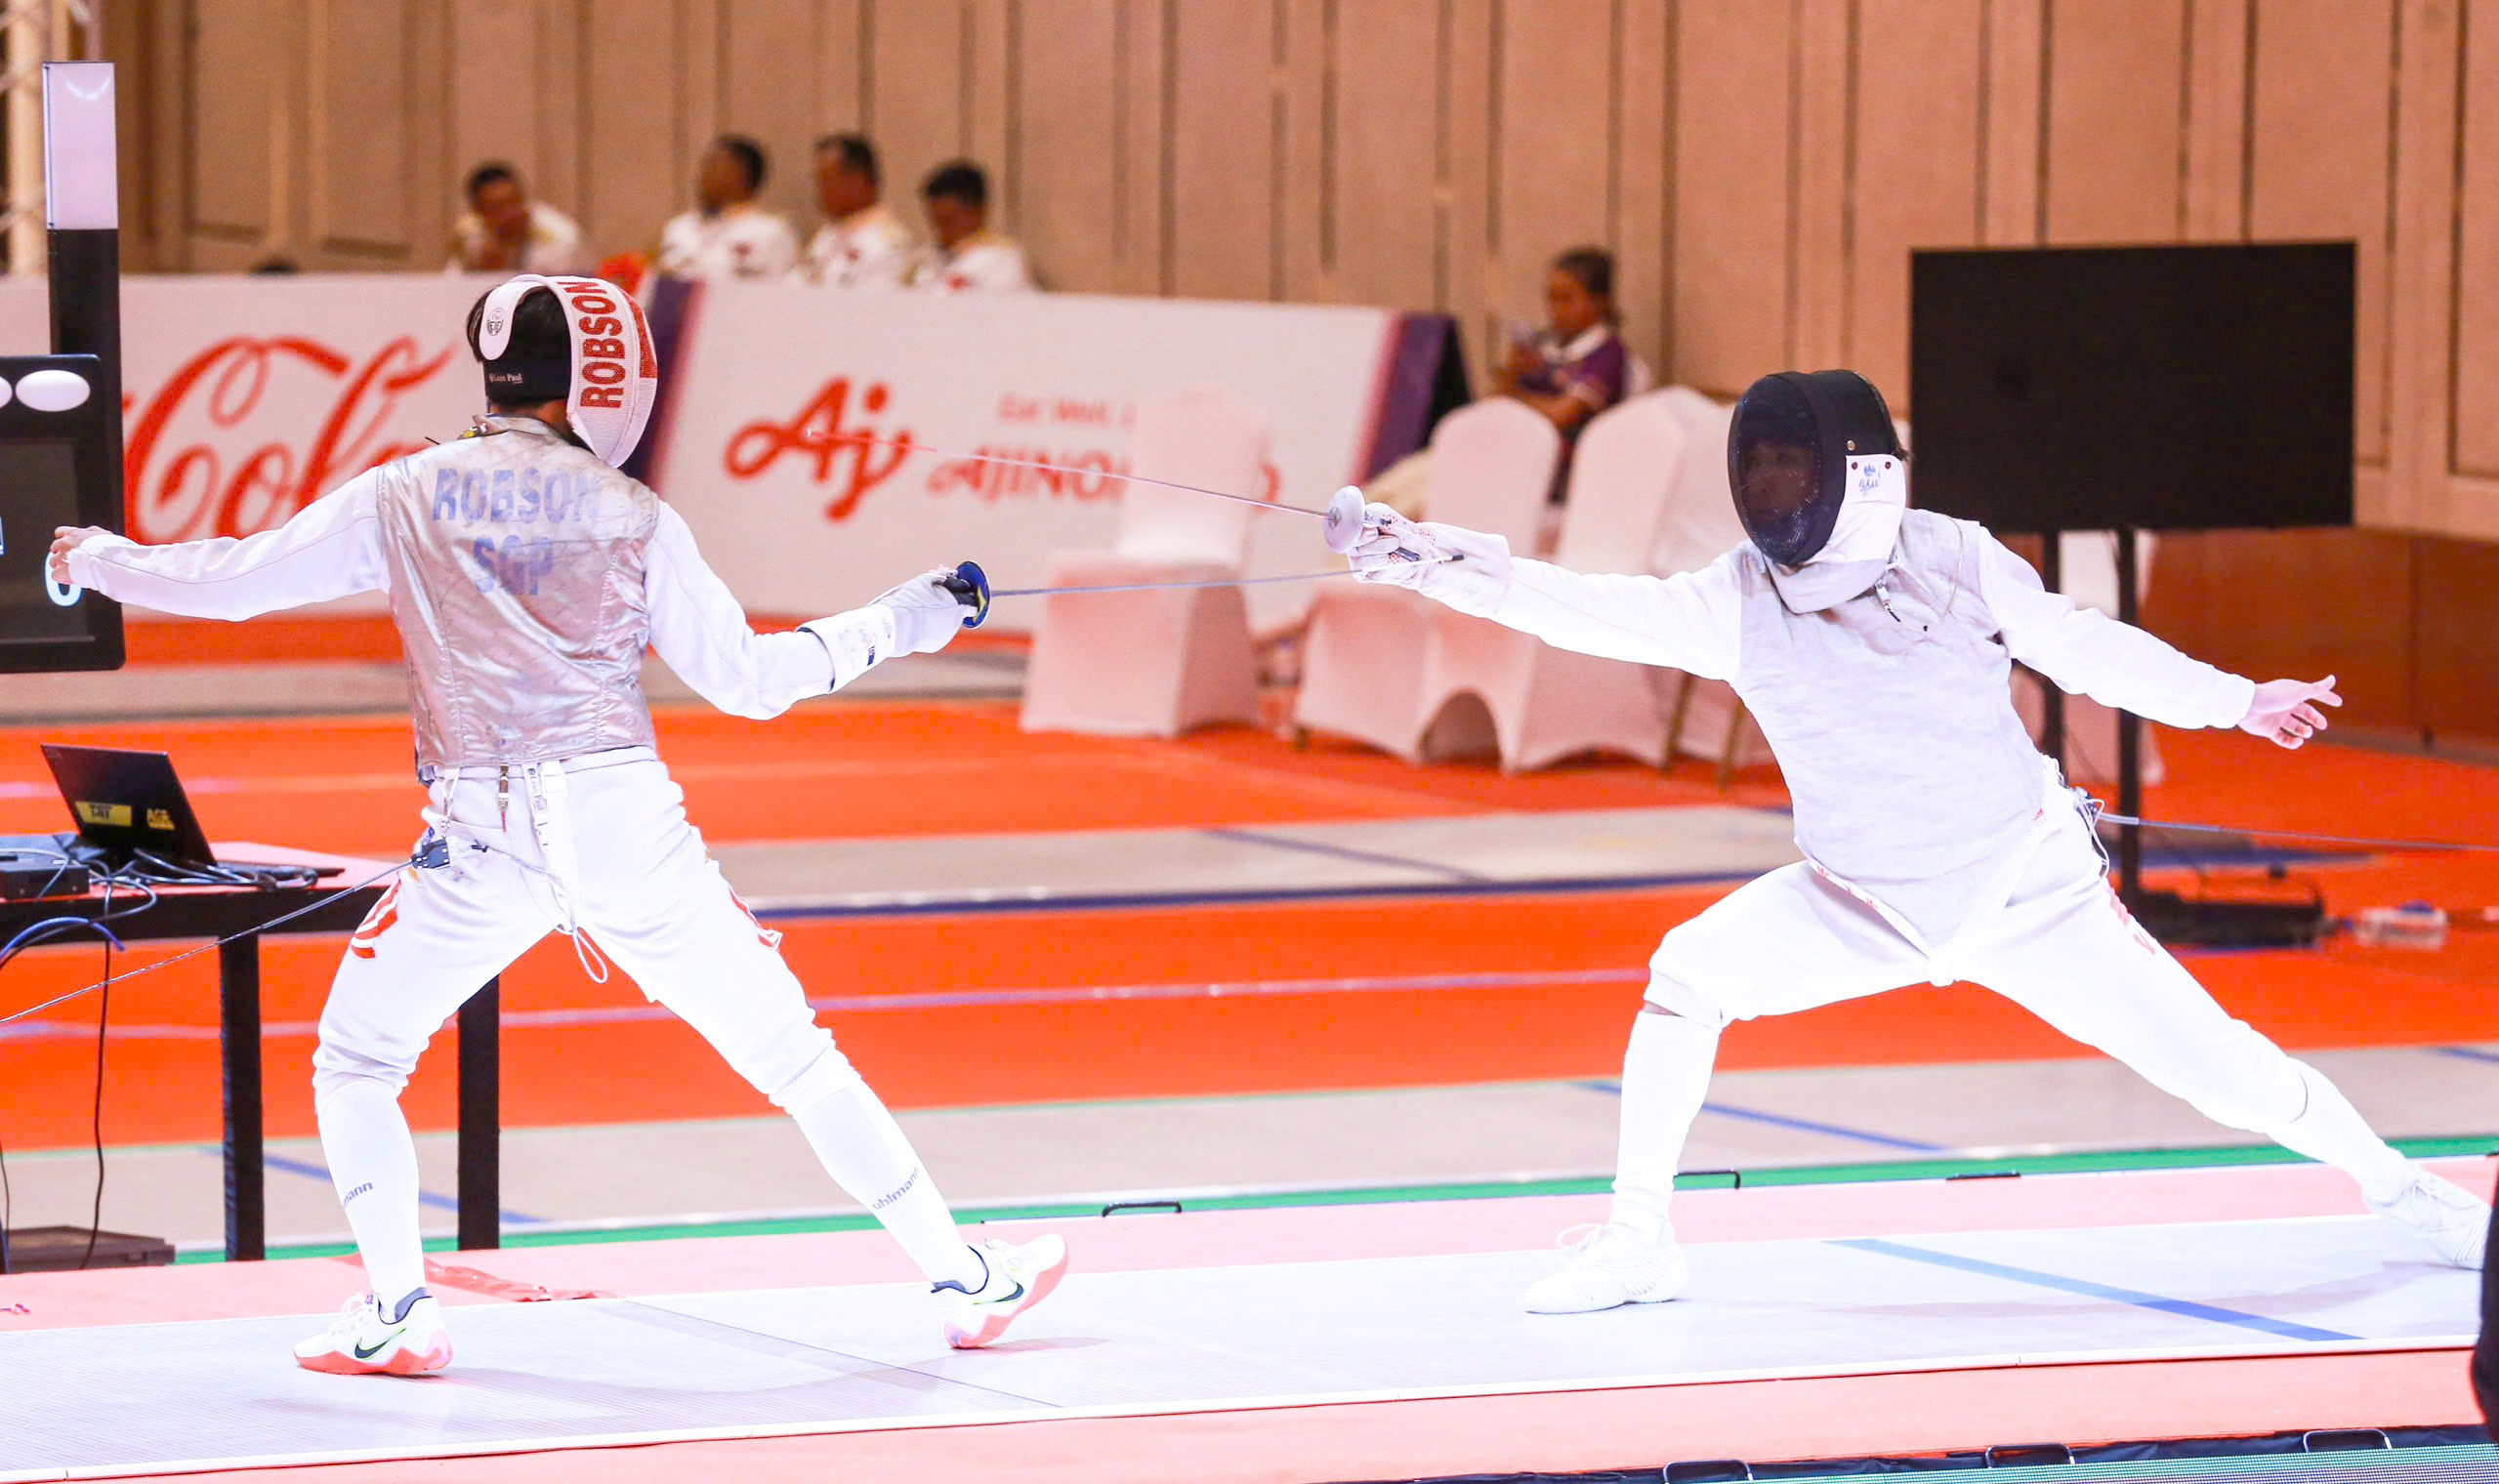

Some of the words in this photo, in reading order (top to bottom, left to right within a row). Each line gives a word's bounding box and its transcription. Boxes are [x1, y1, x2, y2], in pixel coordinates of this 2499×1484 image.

[557, 281, 626, 408] ROBSON
[123, 335, 463, 547] Col
[724, 375, 912, 522] Aj
[433, 468, 604, 523] ROBSON
[473, 534, 554, 596] SGP
[871, 1167, 920, 1211] uhlmann
